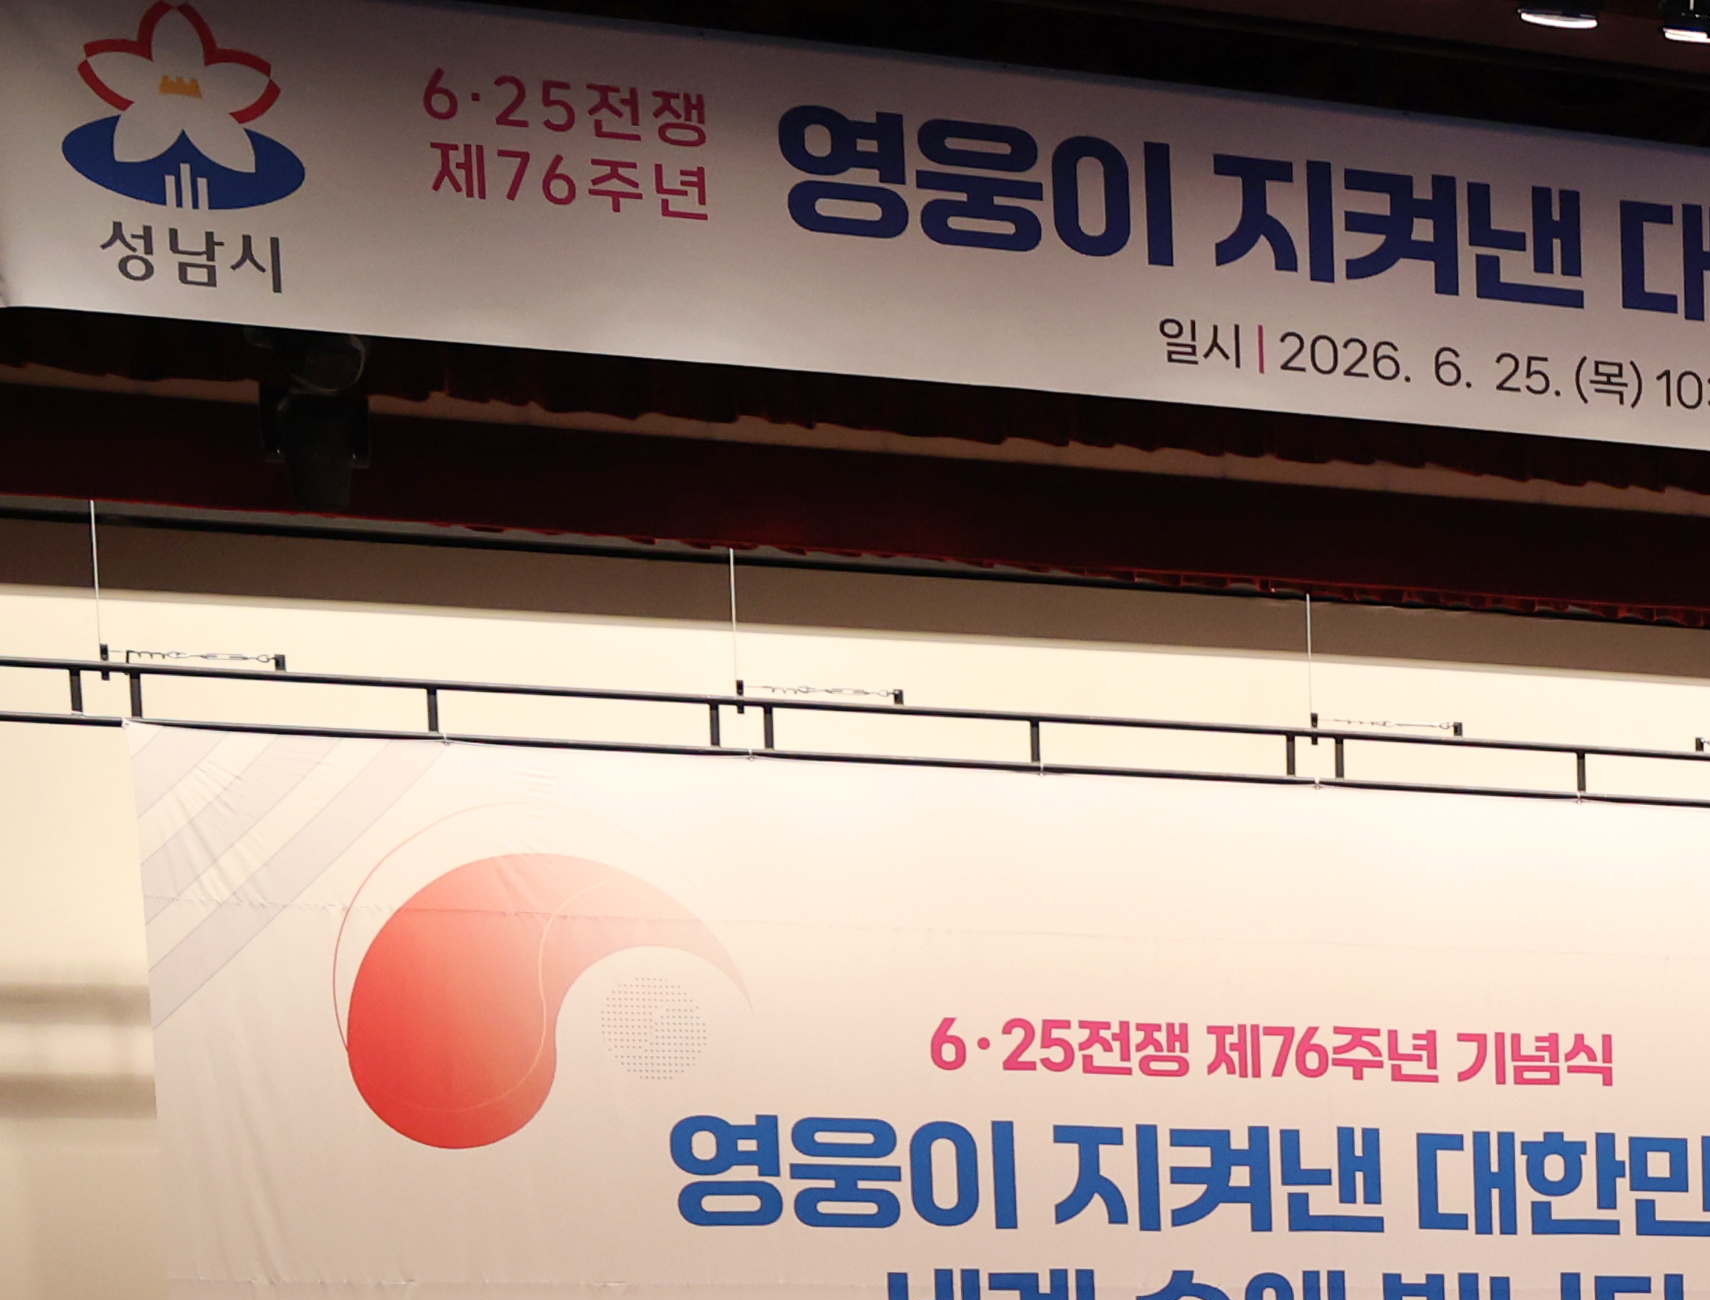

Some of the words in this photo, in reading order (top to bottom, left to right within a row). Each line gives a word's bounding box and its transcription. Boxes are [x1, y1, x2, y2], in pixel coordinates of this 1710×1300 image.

[428, 138, 710, 222] 제76주년
[776, 102, 1175, 268] 영웅이
[1213, 153, 1585, 308] 지켜낸
[99, 220, 284, 294] 성남시
[1158, 316, 1240, 370] 일시
[1279, 331, 1411, 384] 2026.
[1433, 346, 1472, 389] 6.
[930, 1016, 1190, 1079] 6·25전쟁
[1206, 1022, 1440, 1086] 제76주년
[1456, 1030, 1616, 1087] 기념식
[669, 1114, 1018, 1229] 영웅이
[1053, 1123, 1385, 1233] 지켜낸
